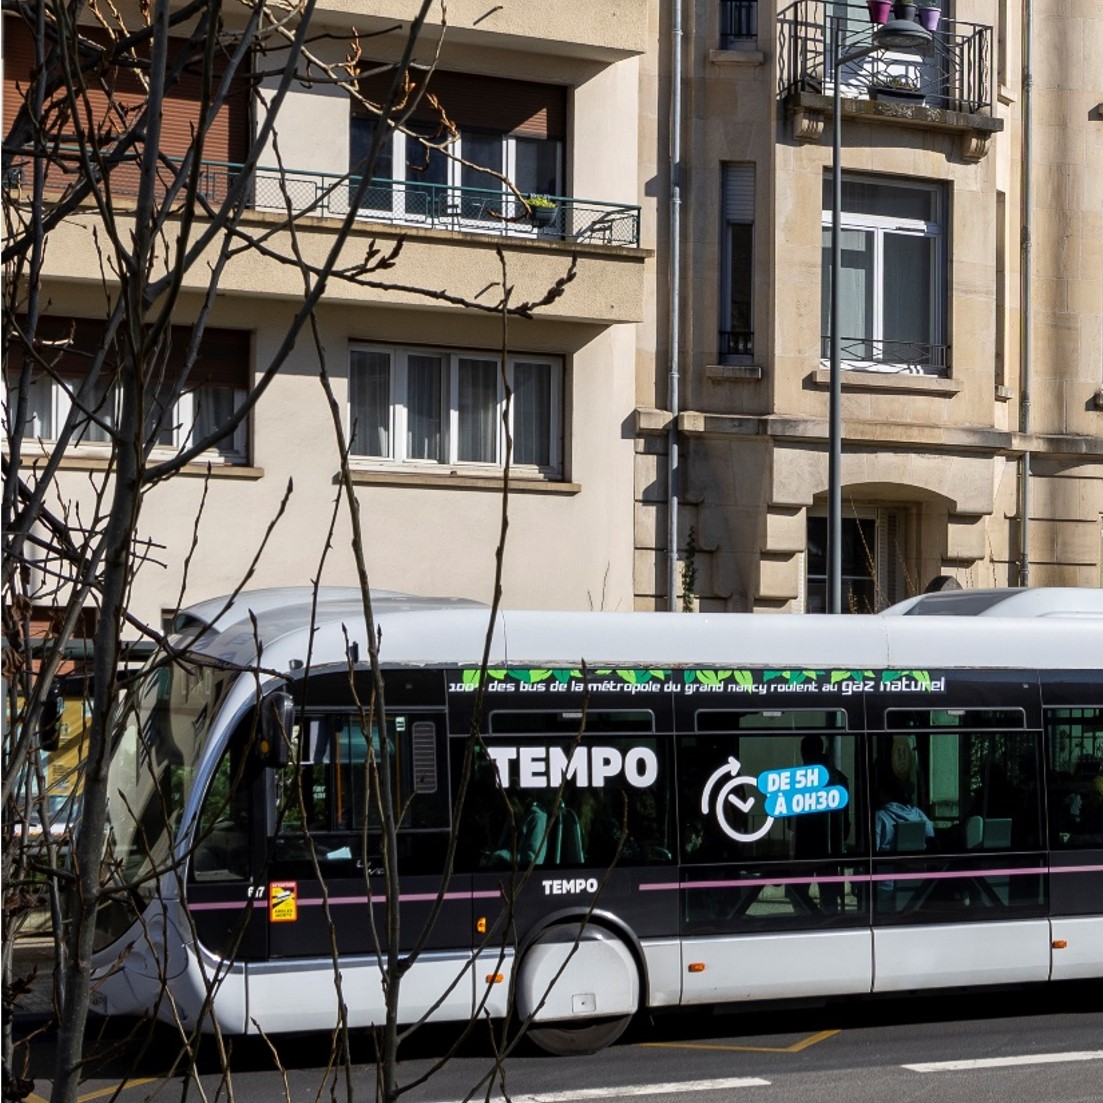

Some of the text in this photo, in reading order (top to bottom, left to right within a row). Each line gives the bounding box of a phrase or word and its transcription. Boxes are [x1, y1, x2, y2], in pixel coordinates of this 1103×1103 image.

[488, 681, 516, 692] des
[519, 680, 548, 692] bus
[550, 680, 568, 692] de
[571, 680, 584, 692] la
[588, 680, 661, 694] métropole
[664, 680, 681, 692] du
[684, 681, 724, 695] grand
[728, 682, 767, 695] nancy
[770, 681, 818, 693] roulent
[822, 682, 837, 692] au
[842, 680, 875, 695] gaz
[880, 677, 945, 693] naturel
[487, 746, 658, 788] TEMPO
[767, 768, 819, 792] DE 5H
[774, 789, 840, 815] À 0H30
[542, 878, 598, 895] TEMPO
